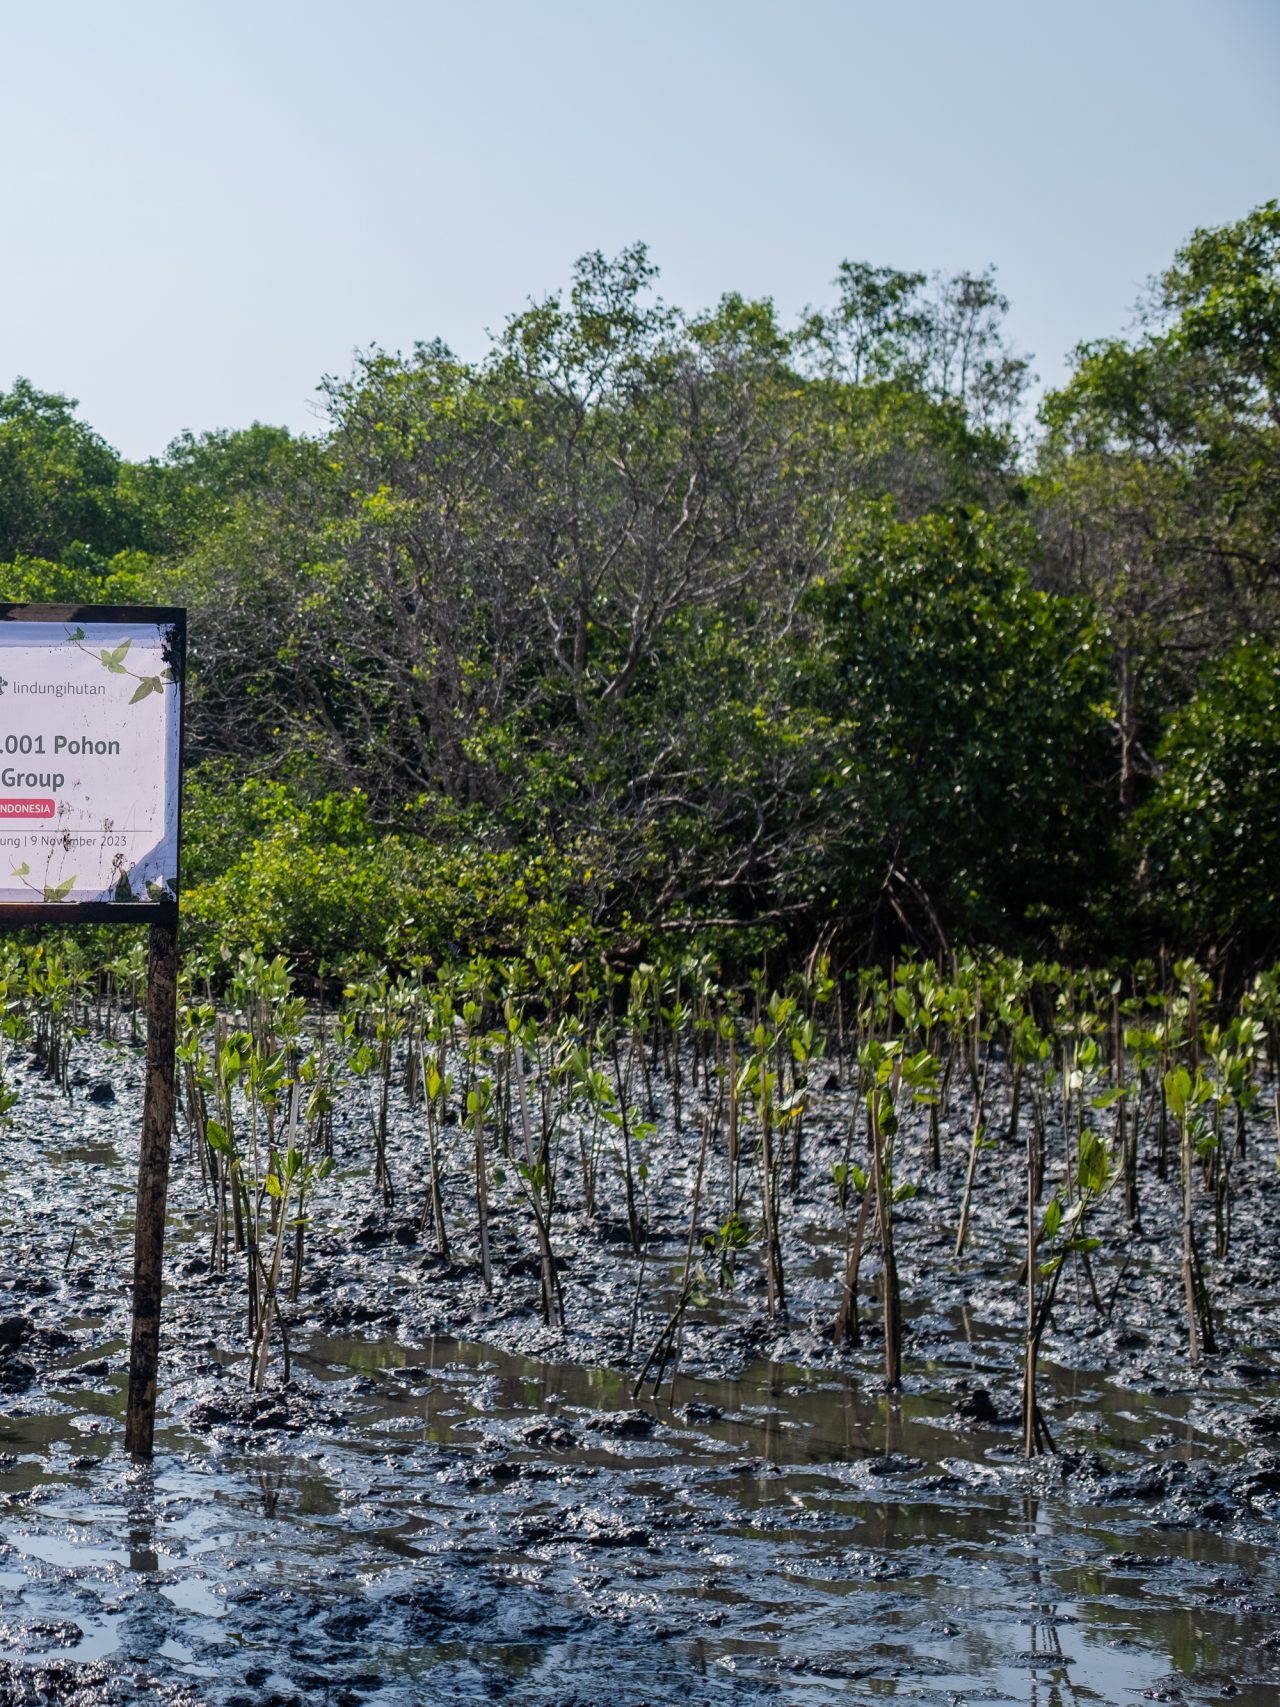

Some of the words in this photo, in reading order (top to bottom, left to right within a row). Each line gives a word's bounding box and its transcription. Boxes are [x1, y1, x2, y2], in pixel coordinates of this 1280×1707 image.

[13, 681, 106, 697] lindungihutan
[54, 736, 120, 754] Pohon
[1, 768, 65, 792] Group
[30, 835, 37, 846] 9
[41, 836, 96, 847] Novmber
[100, 836, 127, 847] 2023
